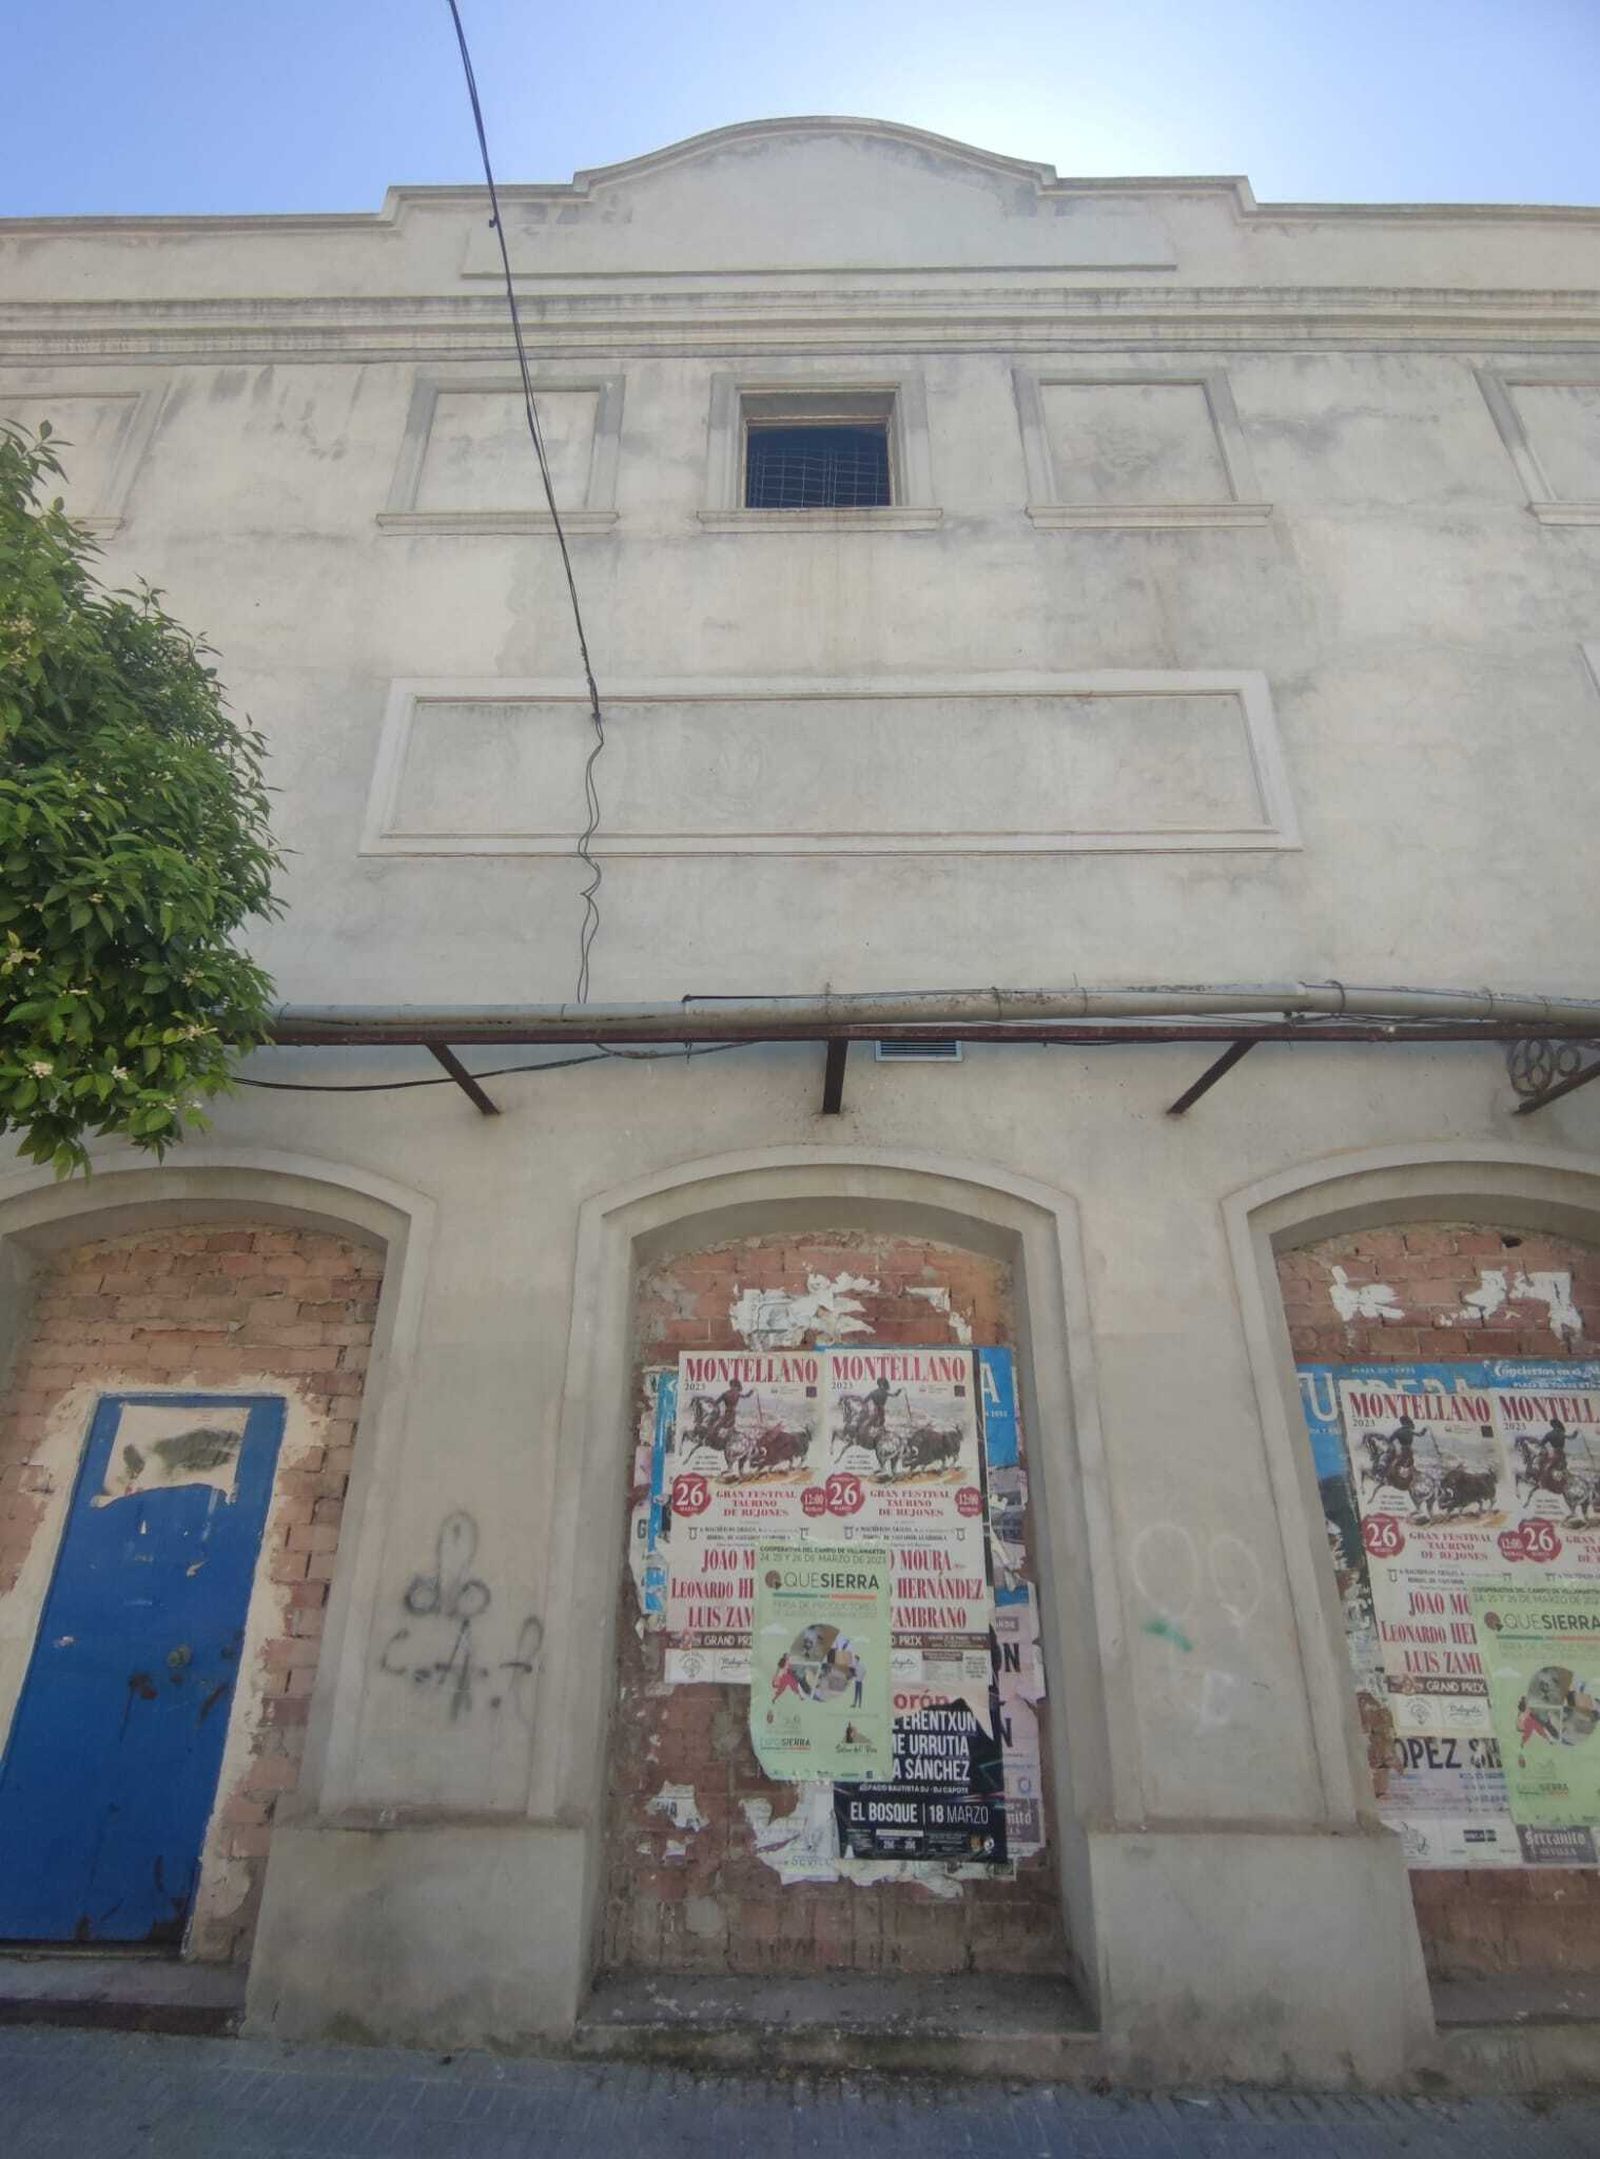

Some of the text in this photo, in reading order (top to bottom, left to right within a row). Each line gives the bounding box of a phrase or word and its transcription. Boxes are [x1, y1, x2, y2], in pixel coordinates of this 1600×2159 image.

[685, 1358, 818, 1383] MONTELLANO
[832, 1355, 966, 1382] MONTELLANO
[1494, 1360, 1555, 1377] Conciertos
[684, 1383, 706, 1391] 2023
[831, 1381, 854, 1390] 2023
[1349, 1392, 1491, 1423] MONTELLANO
[1353, 1419, 1376, 1428] 2023
[1503, 1422, 1527, 1431] 2023
[676, 1482, 704, 1507] 26
[716, 1489, 797, 1500] GRAN FESTIVAL
[830, 1482, 857, 1506] 26
[870, 1489, 950, 1499] GRAN FESTIVAL
[733, 1500, 777, 1508] TAURINO
[887, 1499, 932, 1508] TAURINO
[723, 1508, 789, 1518] DE REJONES
[878, 1508, 944, 1518] DE REJONES
[1366, 1522, 1398, 1548] 26
[1409, 1531, 1491, 1543] GRAN FESTIVAL
[1523, 1527, 1554, 1551] 26
[1428, 1542, 1474, 1551] TAURINO
[805, 1554, 815, 1563] DE
[818, 1554, 851, 1564] MARZO
[853, 1555, 864, 1564] DE
[866, 1556, 887, 1565] 2023
[900, 1550, 952, 1571] MOURA
[1421, 1550, 1488, 1561] DE REJONES
[671, 1577, 733, 1599] LEONARDO
[898, 1570, 984, 1600] HERNÁNDEZ
[688, 1606, 721, 1628] LUIS
[891, 1606, 967, 1628] AMBRANO
[899, 1635, 922, 1646] PRIX
[1381, 1620, 1447, 1644] LEONARDO
[704, 1635, 735, 1647] GRAND
[1404, 1650, 1441, 1675] LUIS
[1426, 1680, 1486, 1693] GRAND PRIX
[902, 1710, 977, 1732] ERENTXUN
[909, 1734, 970, 1756] URRUTIA
[905, 1755, 970, 1780] SÁNCHEZ
[888, 1784, 919, 1793] BAUTISTA
[851, 1802, 989, 1825] EL BOSQUE 18 MARZO
